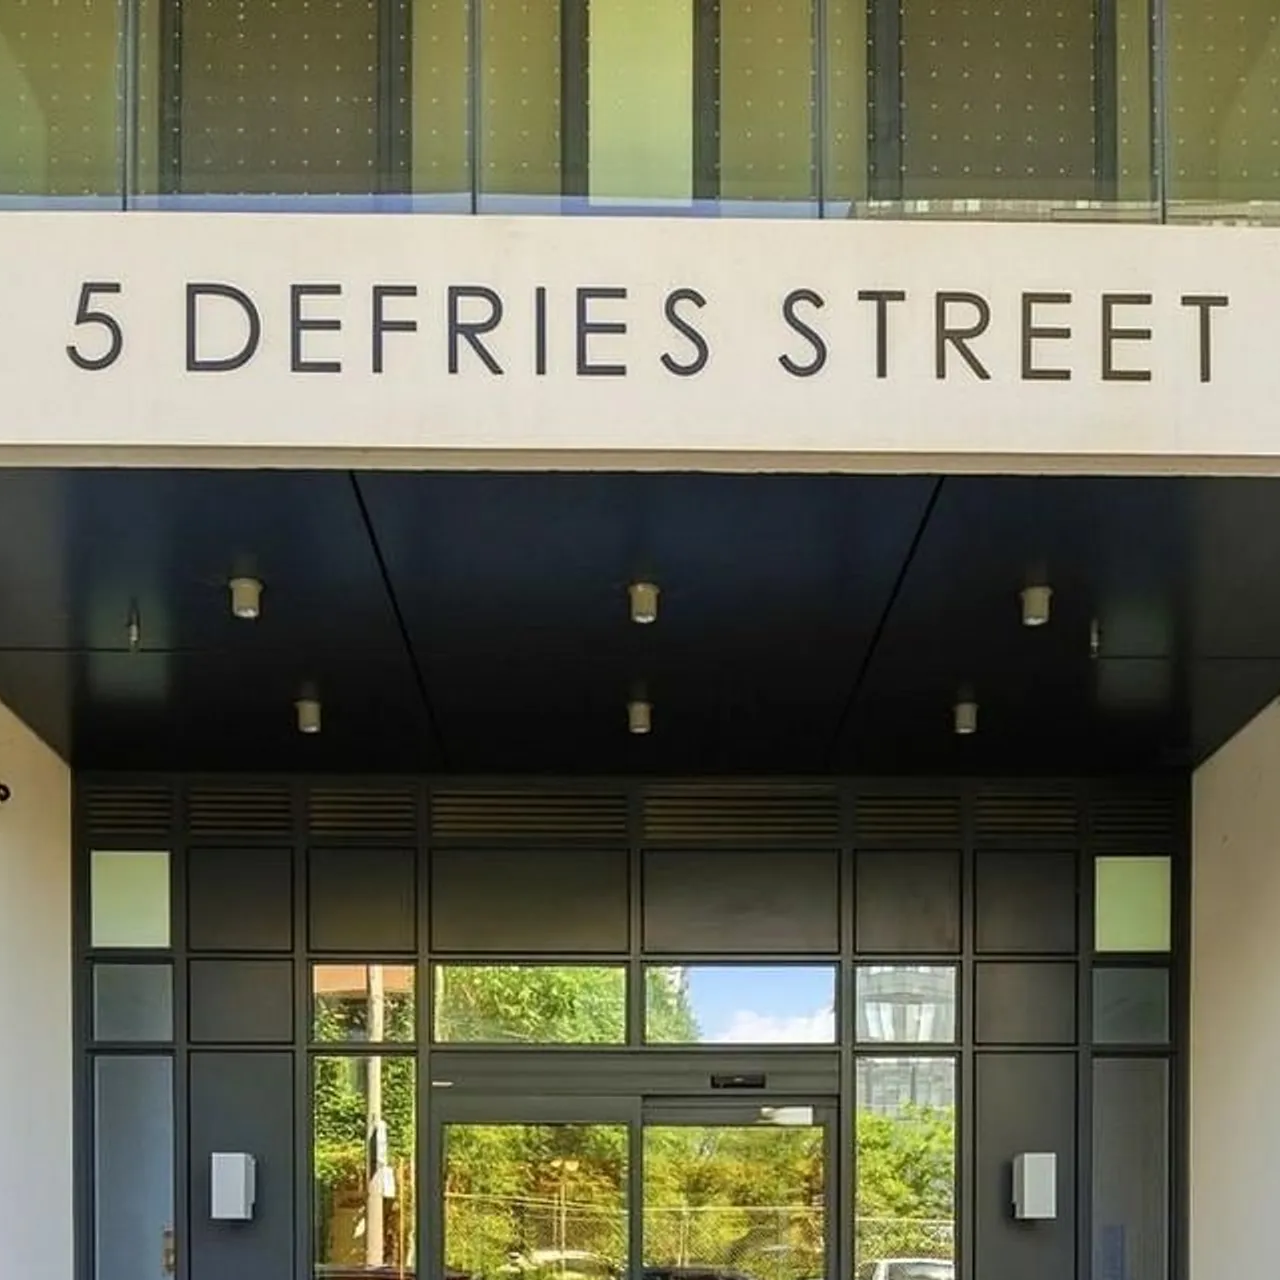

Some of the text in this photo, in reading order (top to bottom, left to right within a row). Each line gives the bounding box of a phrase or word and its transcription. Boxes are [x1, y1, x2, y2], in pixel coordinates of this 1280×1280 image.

[66, 282, 1228, 382] 5 DEFRIES STREET
